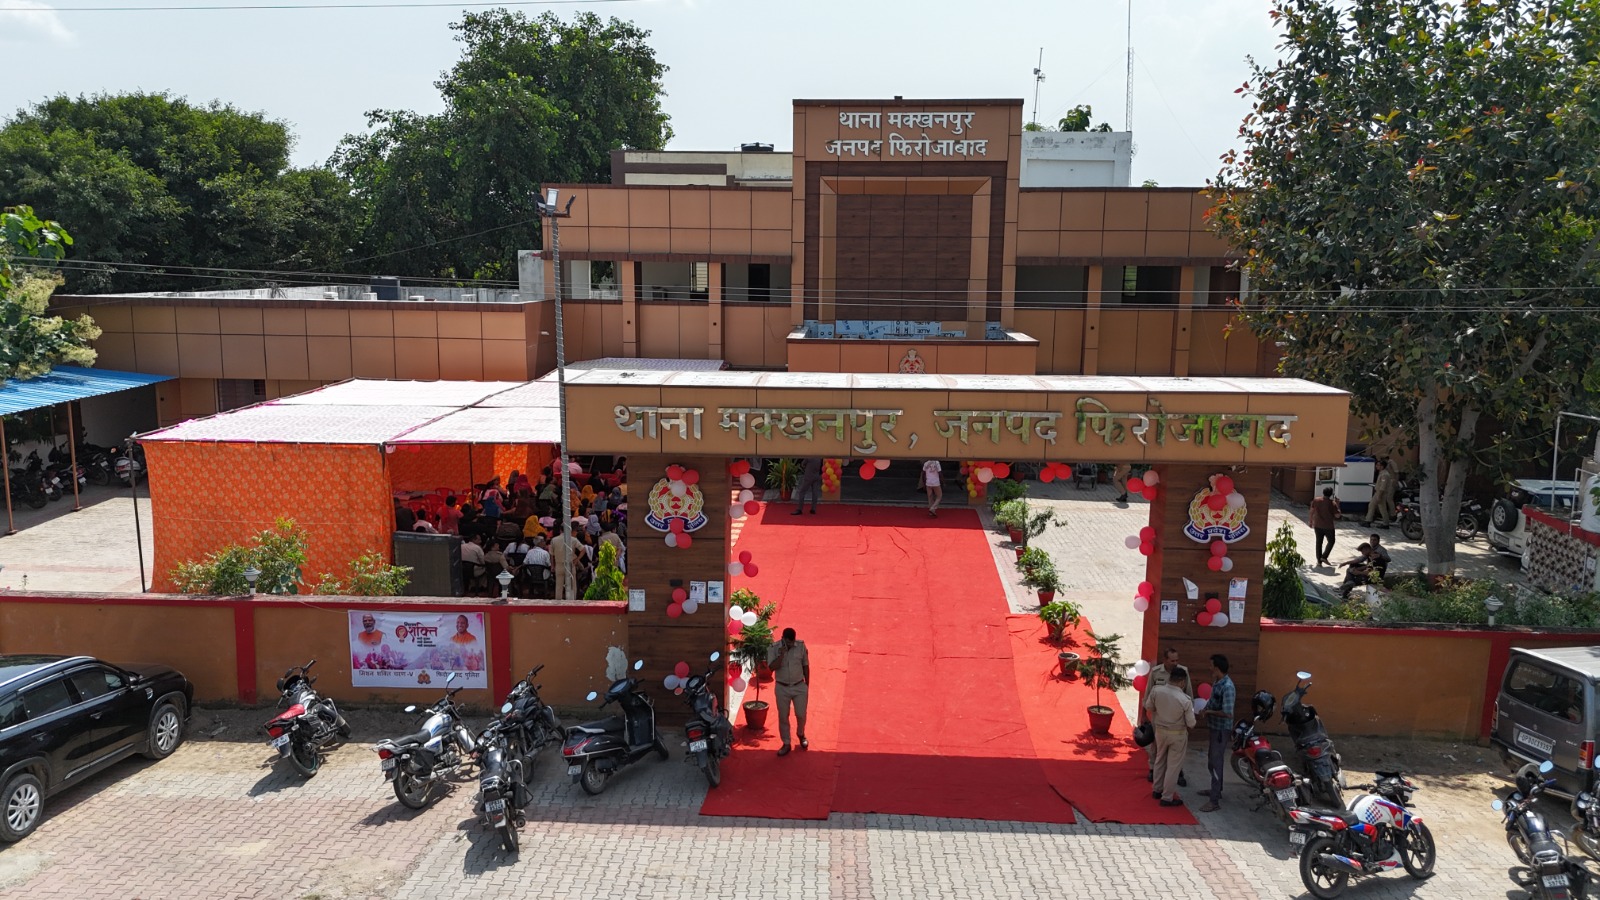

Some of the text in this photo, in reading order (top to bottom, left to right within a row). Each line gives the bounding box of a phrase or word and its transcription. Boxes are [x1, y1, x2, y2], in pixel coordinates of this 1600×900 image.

[839, 112, 975, 135] थाना मक्खनपुर
[825, 132, 988, 157] जनपद फिरोजाबाद
[613, 404, 704, 440] थाना
[933, 409, 1063, 446] जनपद
[1075, 396, 1298, 448] फिरोजाबाद
